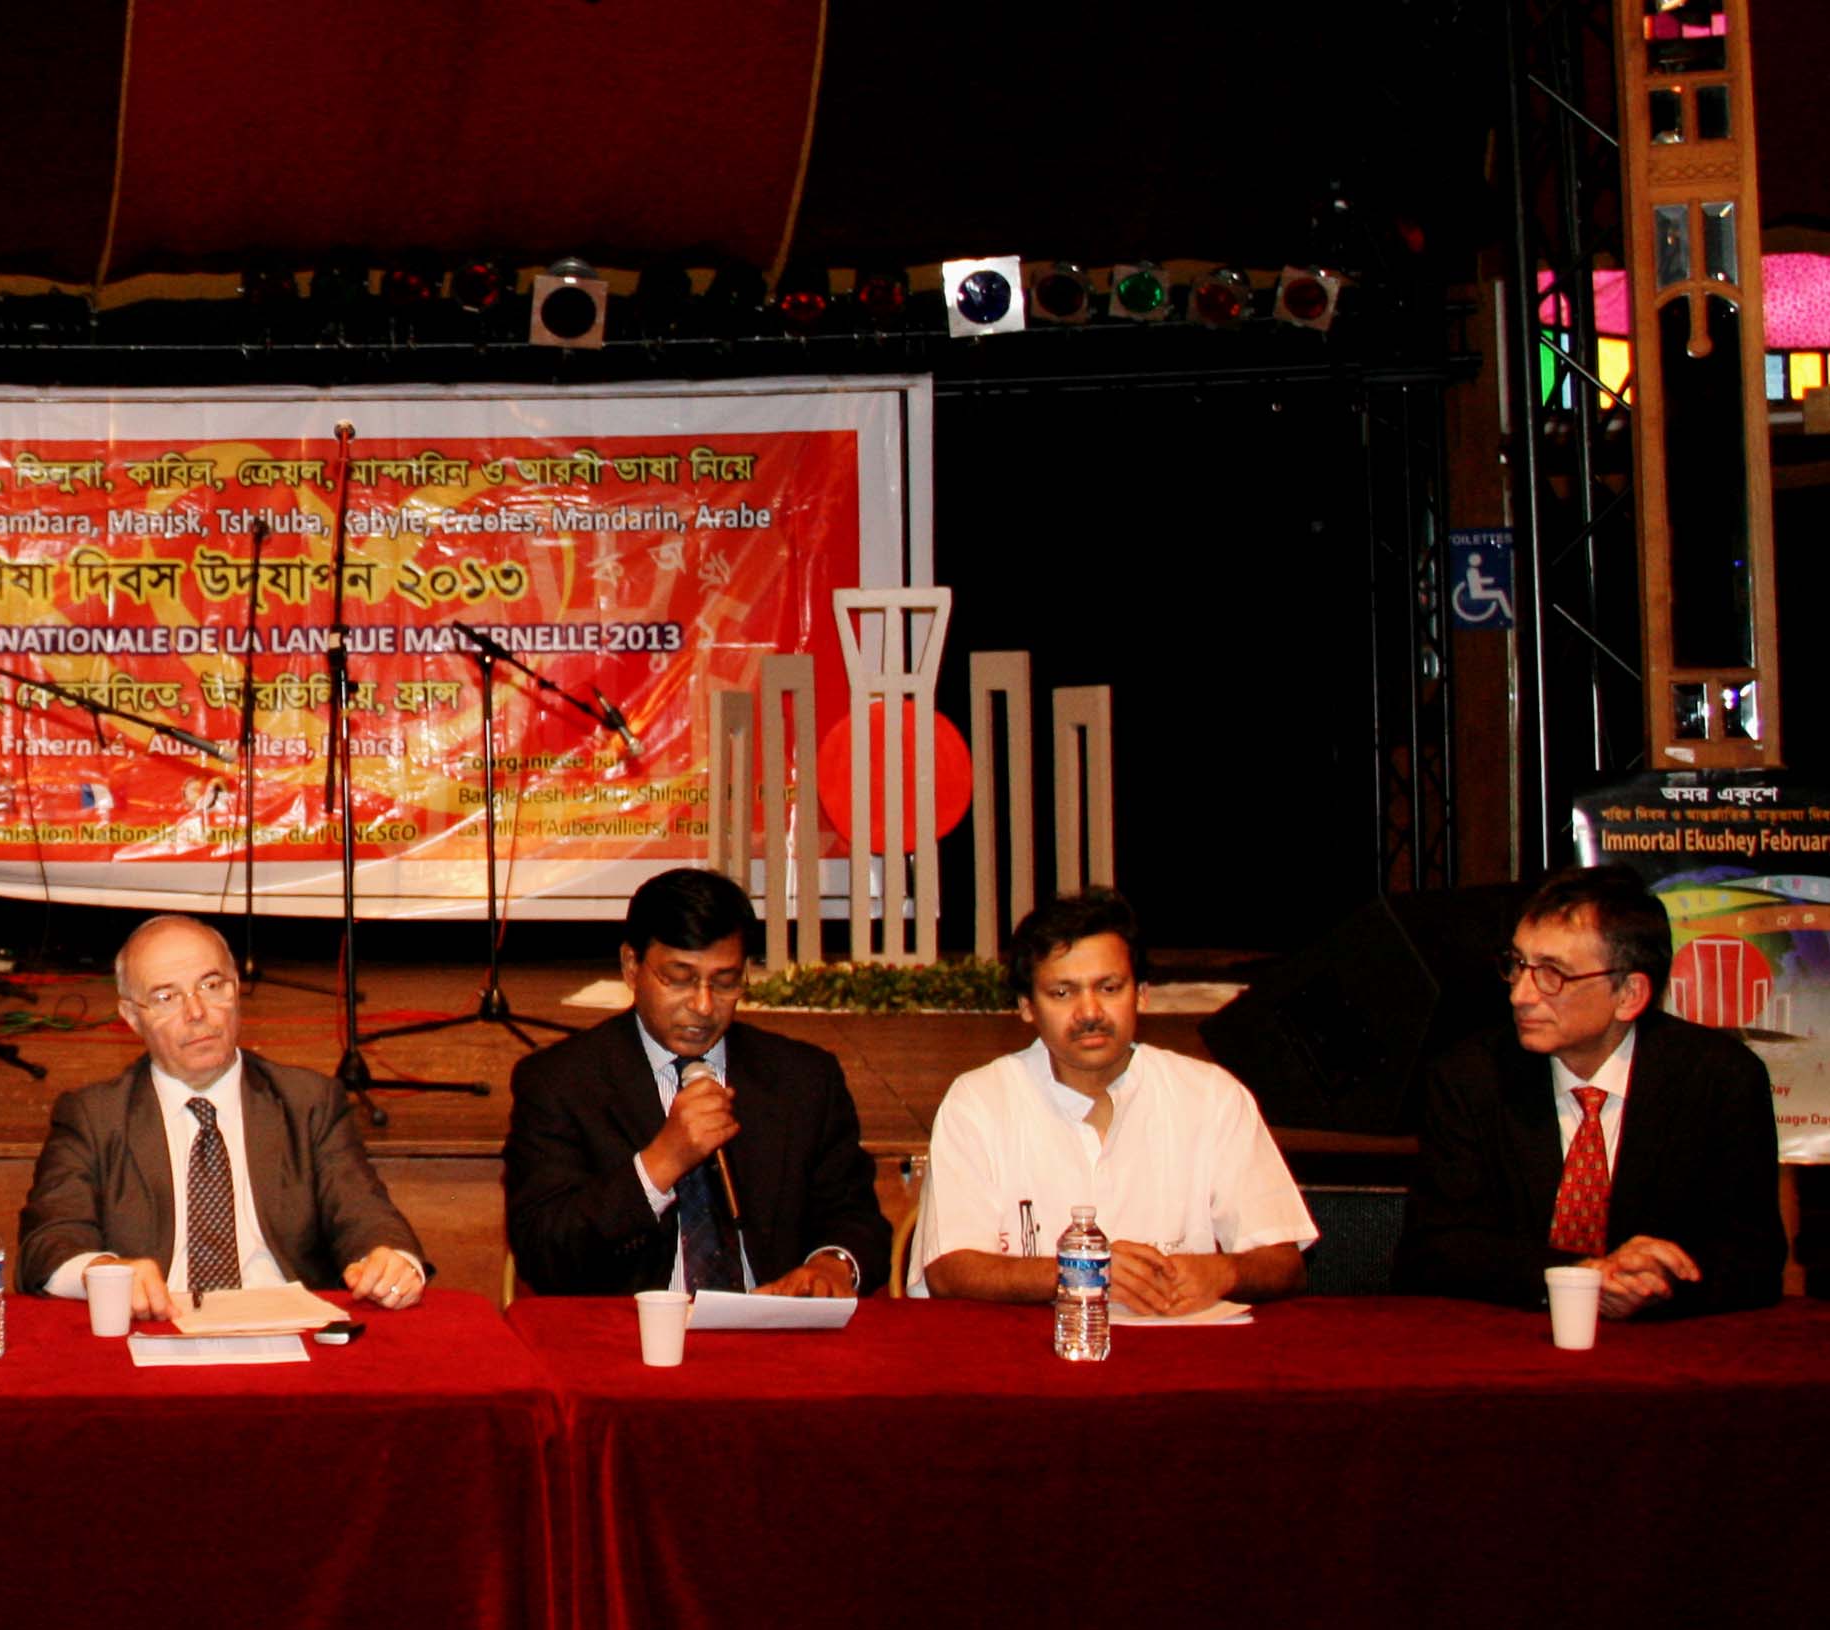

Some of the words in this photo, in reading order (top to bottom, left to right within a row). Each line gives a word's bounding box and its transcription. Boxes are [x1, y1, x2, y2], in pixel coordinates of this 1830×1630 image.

[480, 457, 506, 484] ও
[552, 506, 687, 534] Mandarin,
[695, 502, 771, 529] Arabe
[72, 550, 181, 600] দিবস
[397, 562, 524, 603] ২০১৩
[178, 627, 216, 652] DE
[227, 627, 263, 652] LA
[608, 624, 682, 651] 2013
[322, 735, 406, 757] Fance
[1660, 787, 1710, 802] অমর
[1717, 786, 1779, 806] একুশে
[1602, 828, 1681, 852] Immortal
[1685, 828, 1756, 857] Ekushey
[1761, 828, 1830, 852] Februar
